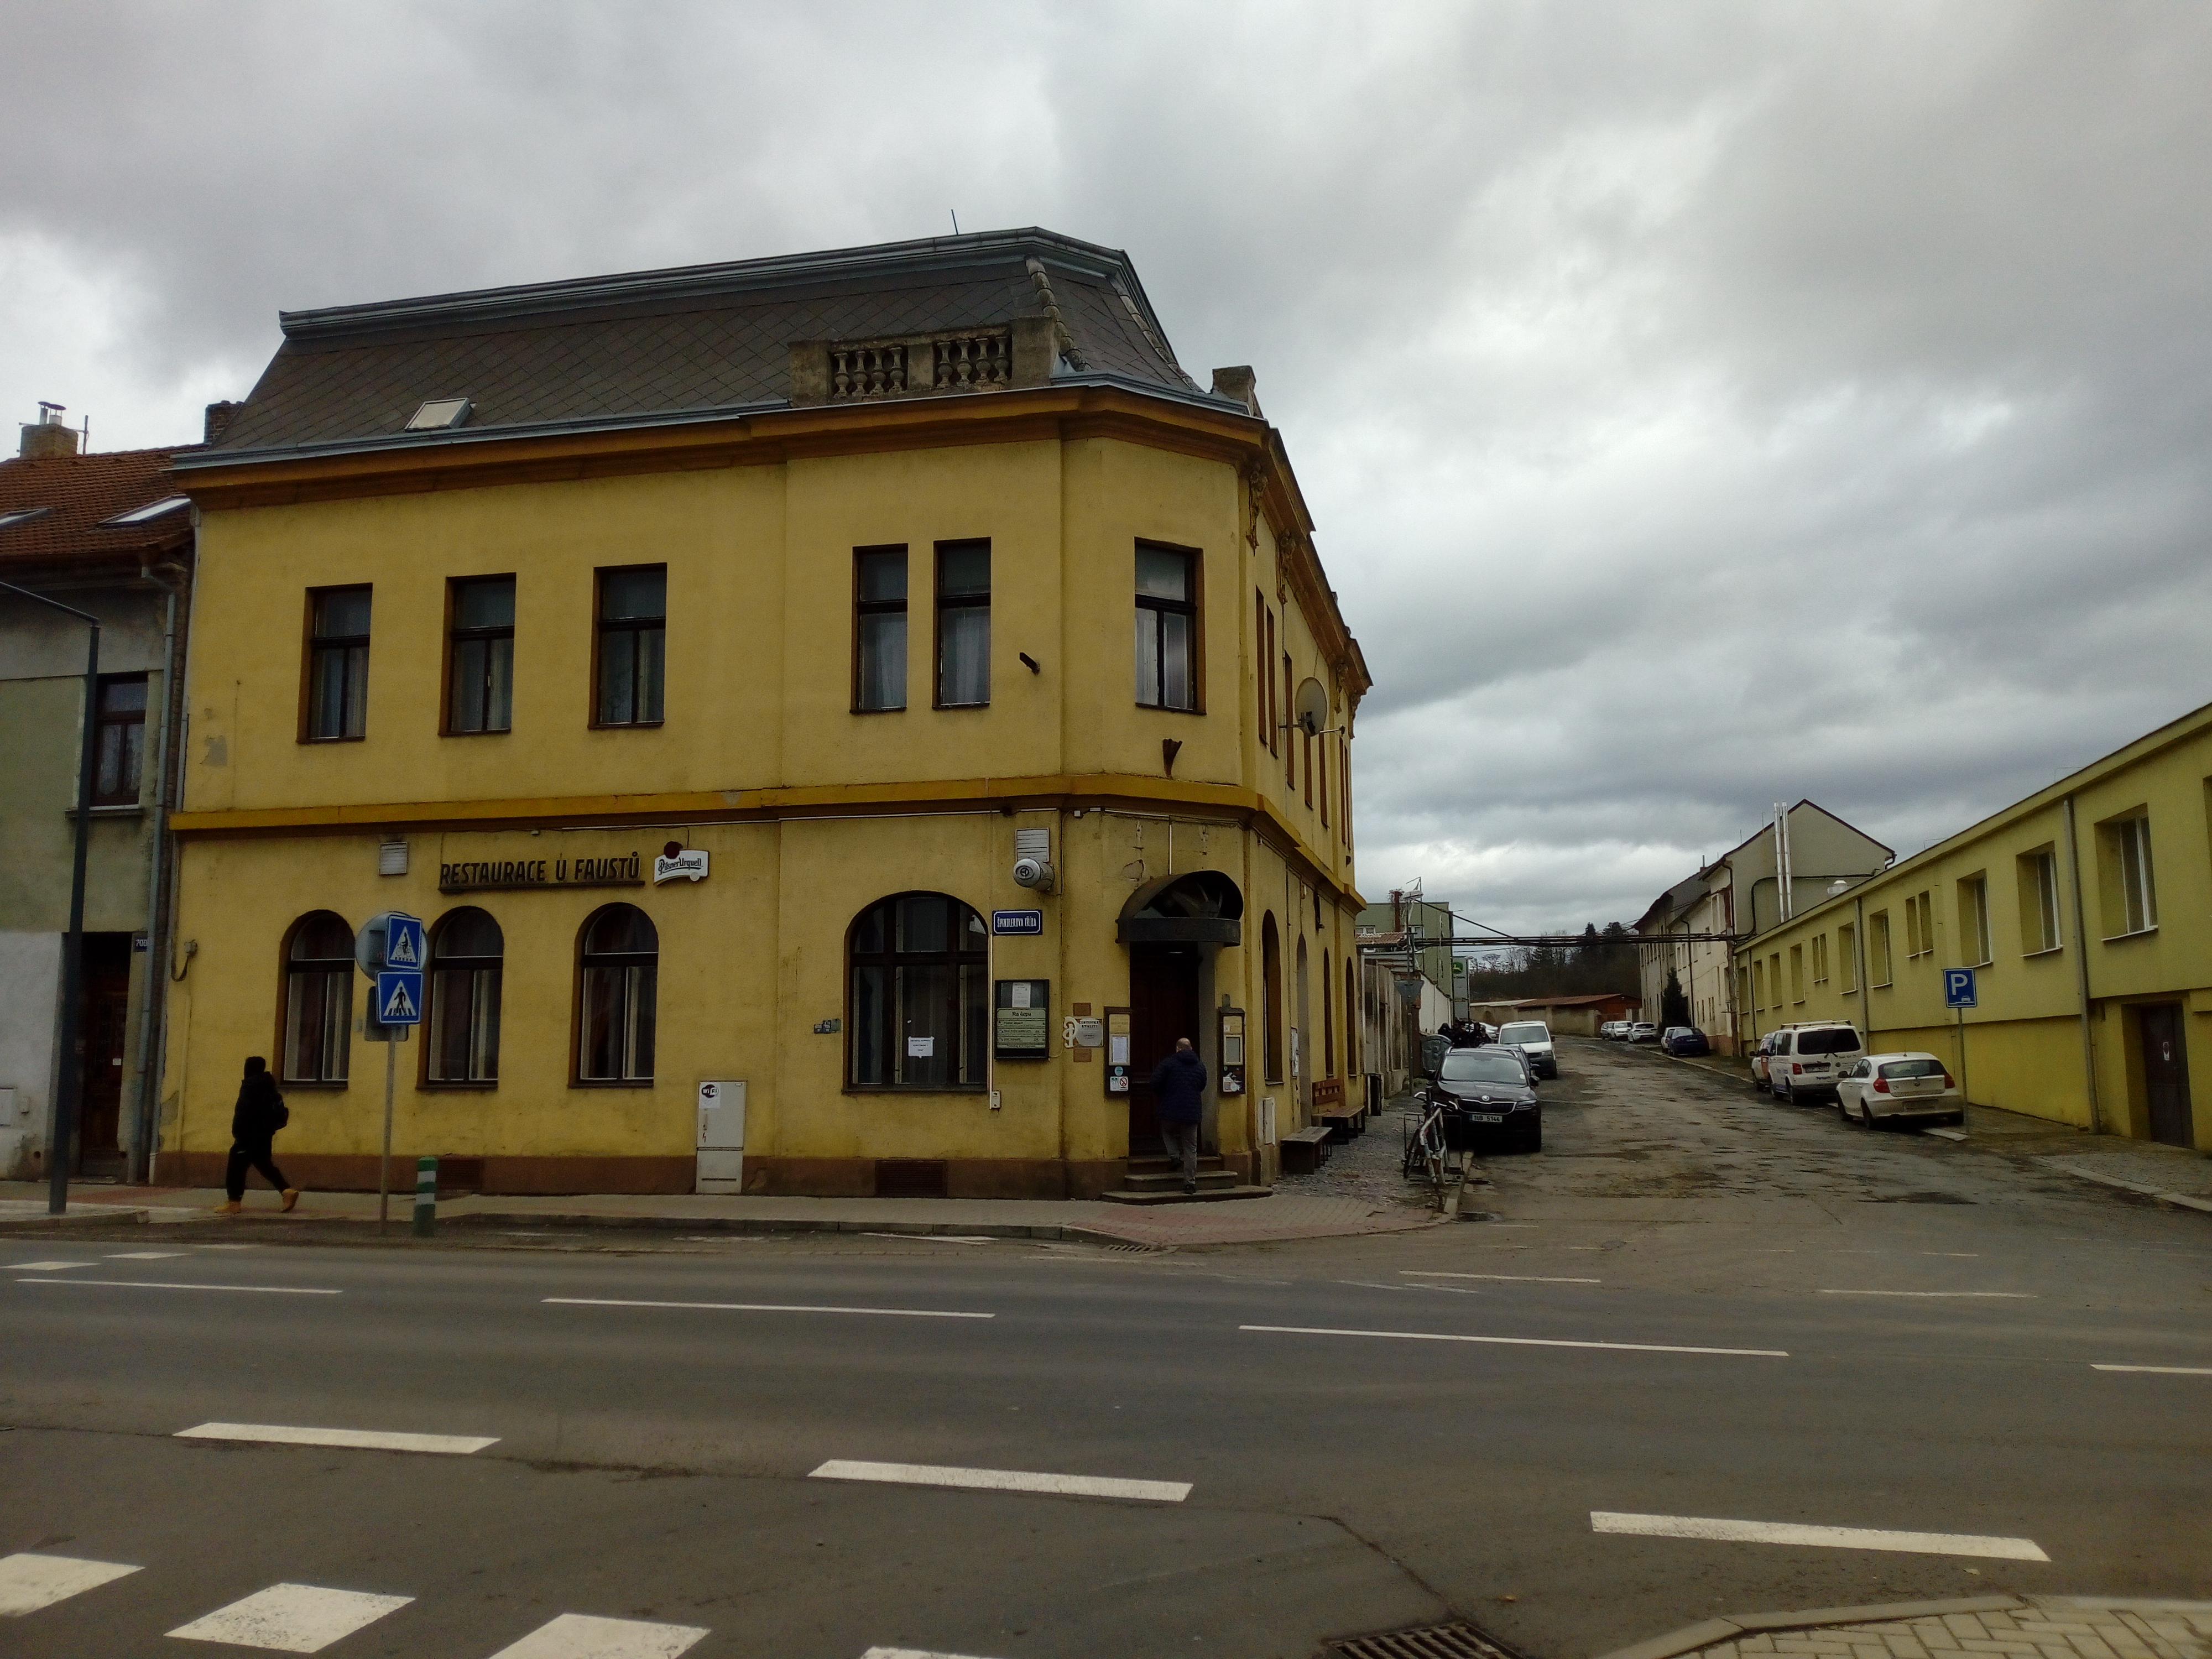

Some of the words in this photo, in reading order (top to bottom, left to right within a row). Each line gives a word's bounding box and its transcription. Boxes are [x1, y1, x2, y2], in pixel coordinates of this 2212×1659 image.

[442, 860, 546, 884] RESTAURACE
[556, 859, 567, 880] U
[575, 851, 640, 880] FAUSTŮ
[659, 859, 679, 875] Pilsner
[679, 857, 701, 870] Urquell
[1950, 973, 1968, 995] P
